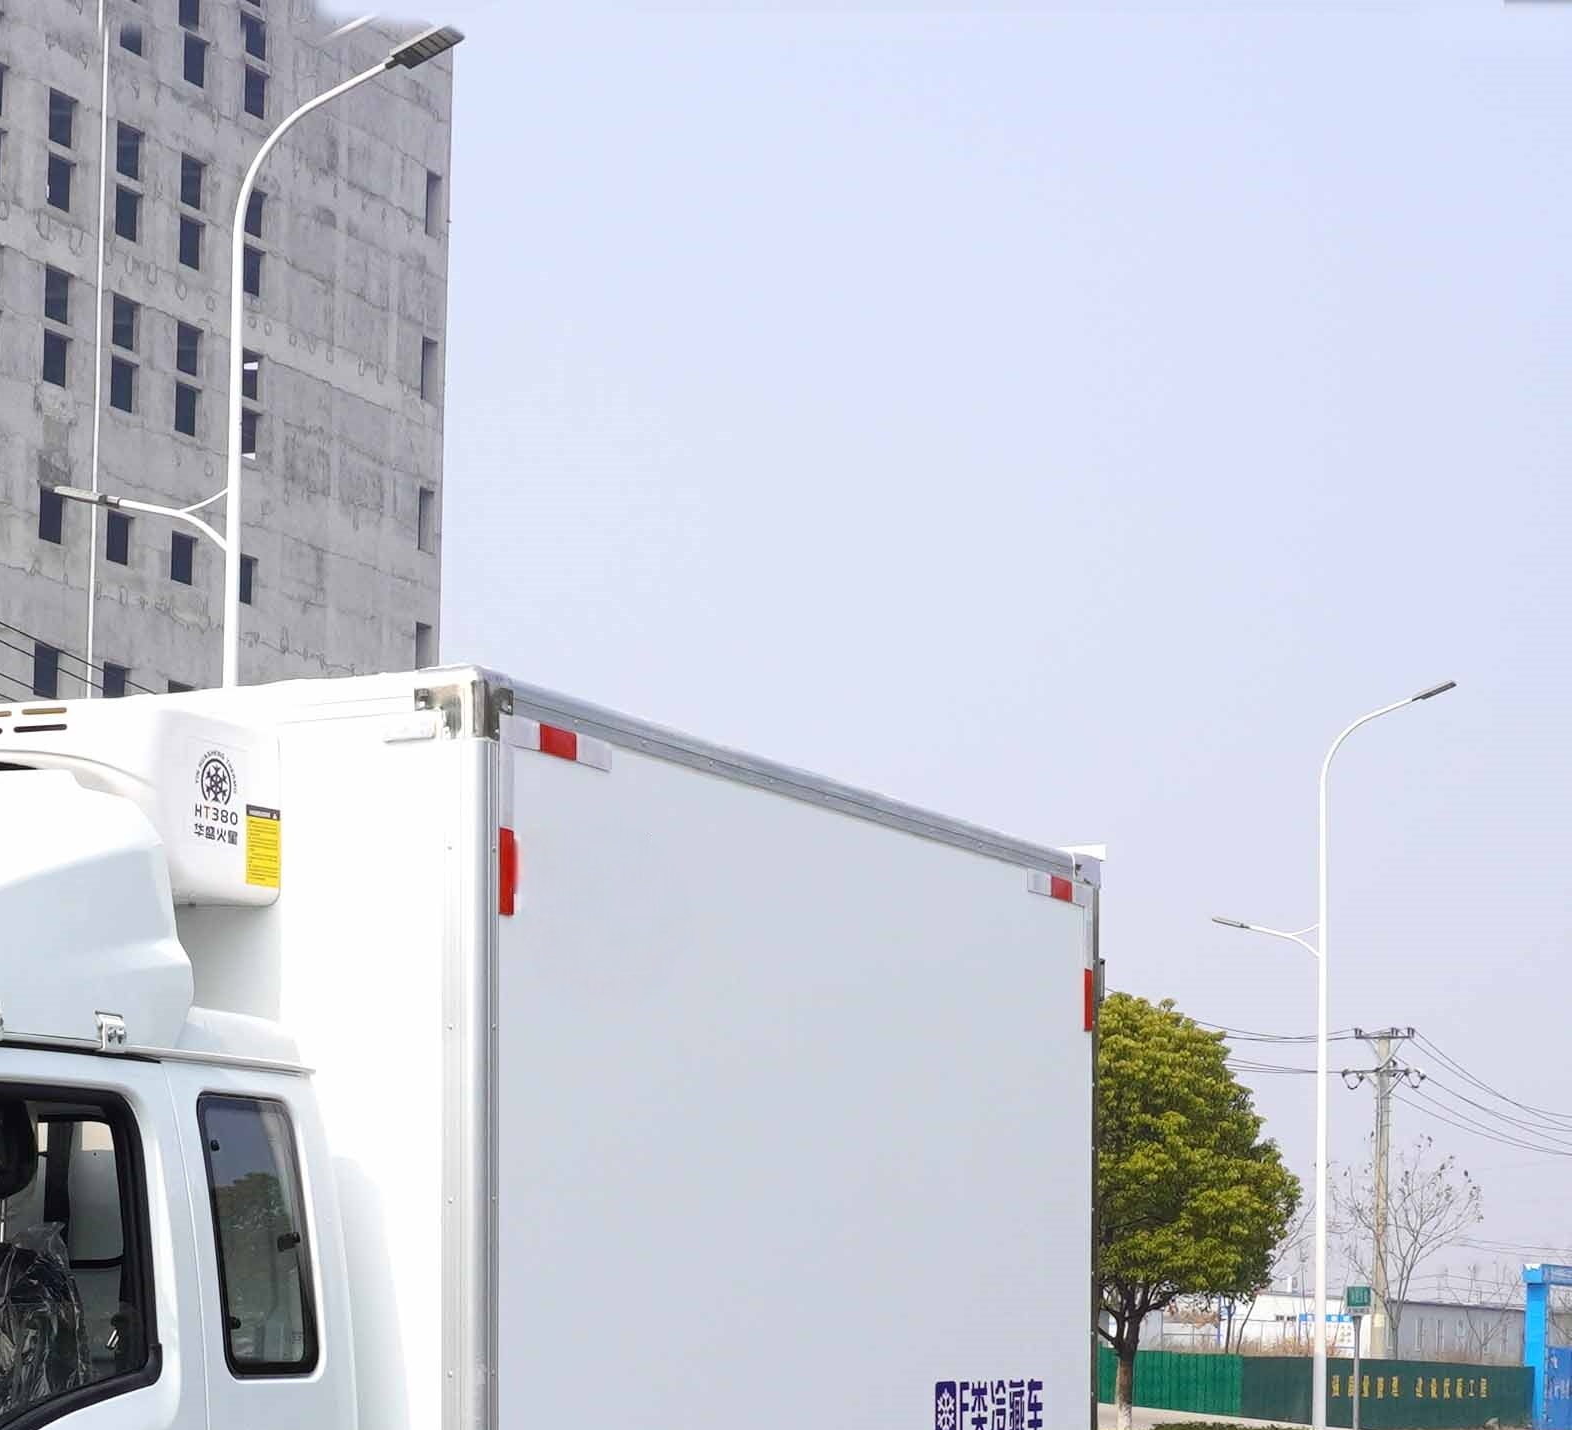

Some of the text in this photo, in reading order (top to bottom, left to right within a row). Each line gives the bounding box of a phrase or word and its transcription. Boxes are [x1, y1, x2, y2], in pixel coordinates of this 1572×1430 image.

[194, 803, 238, 826] HT380
[194, 822, 238, 846] 华盛火星
